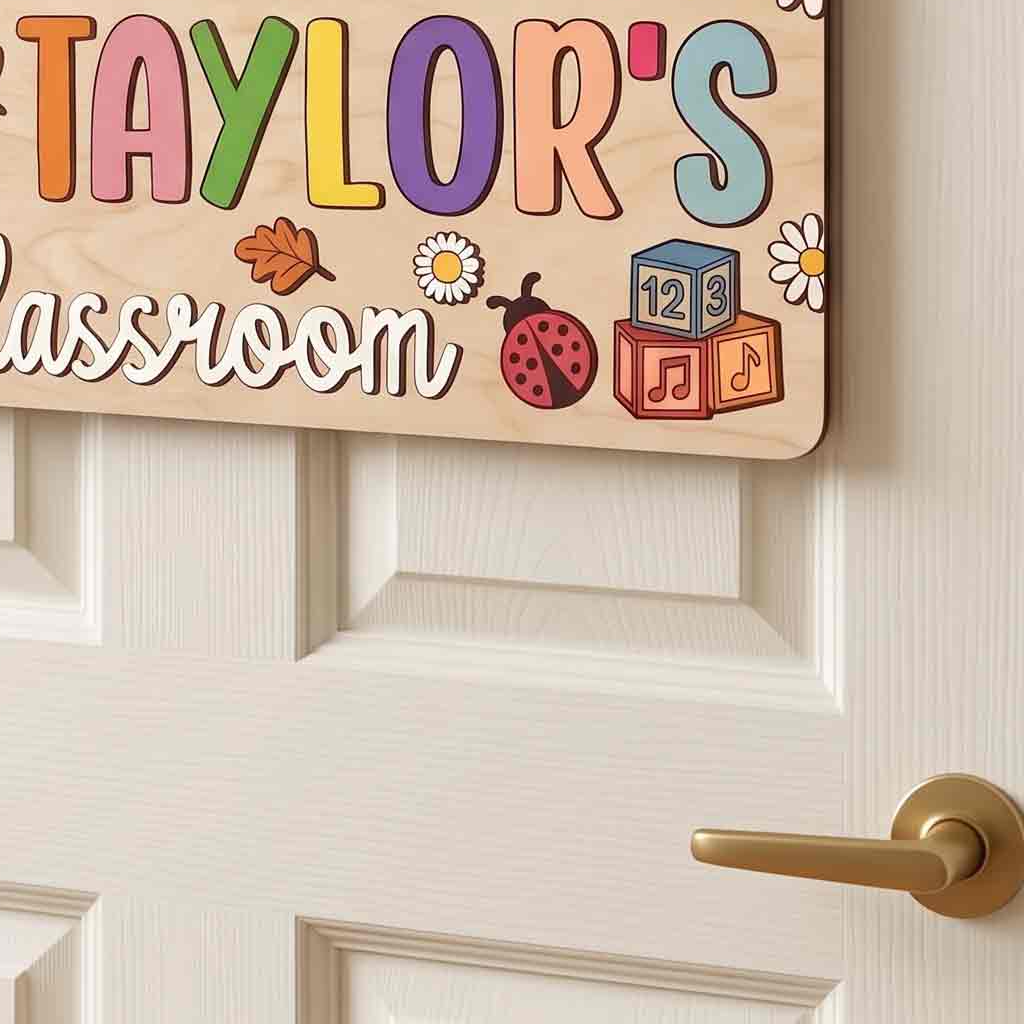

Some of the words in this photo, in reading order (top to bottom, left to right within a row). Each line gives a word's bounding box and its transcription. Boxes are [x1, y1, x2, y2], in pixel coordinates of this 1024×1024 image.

[15, 14, 778, 228] TAYLOR'S
[640, 275, 686, 320] 12
[706, 274, 727, 317] 3
